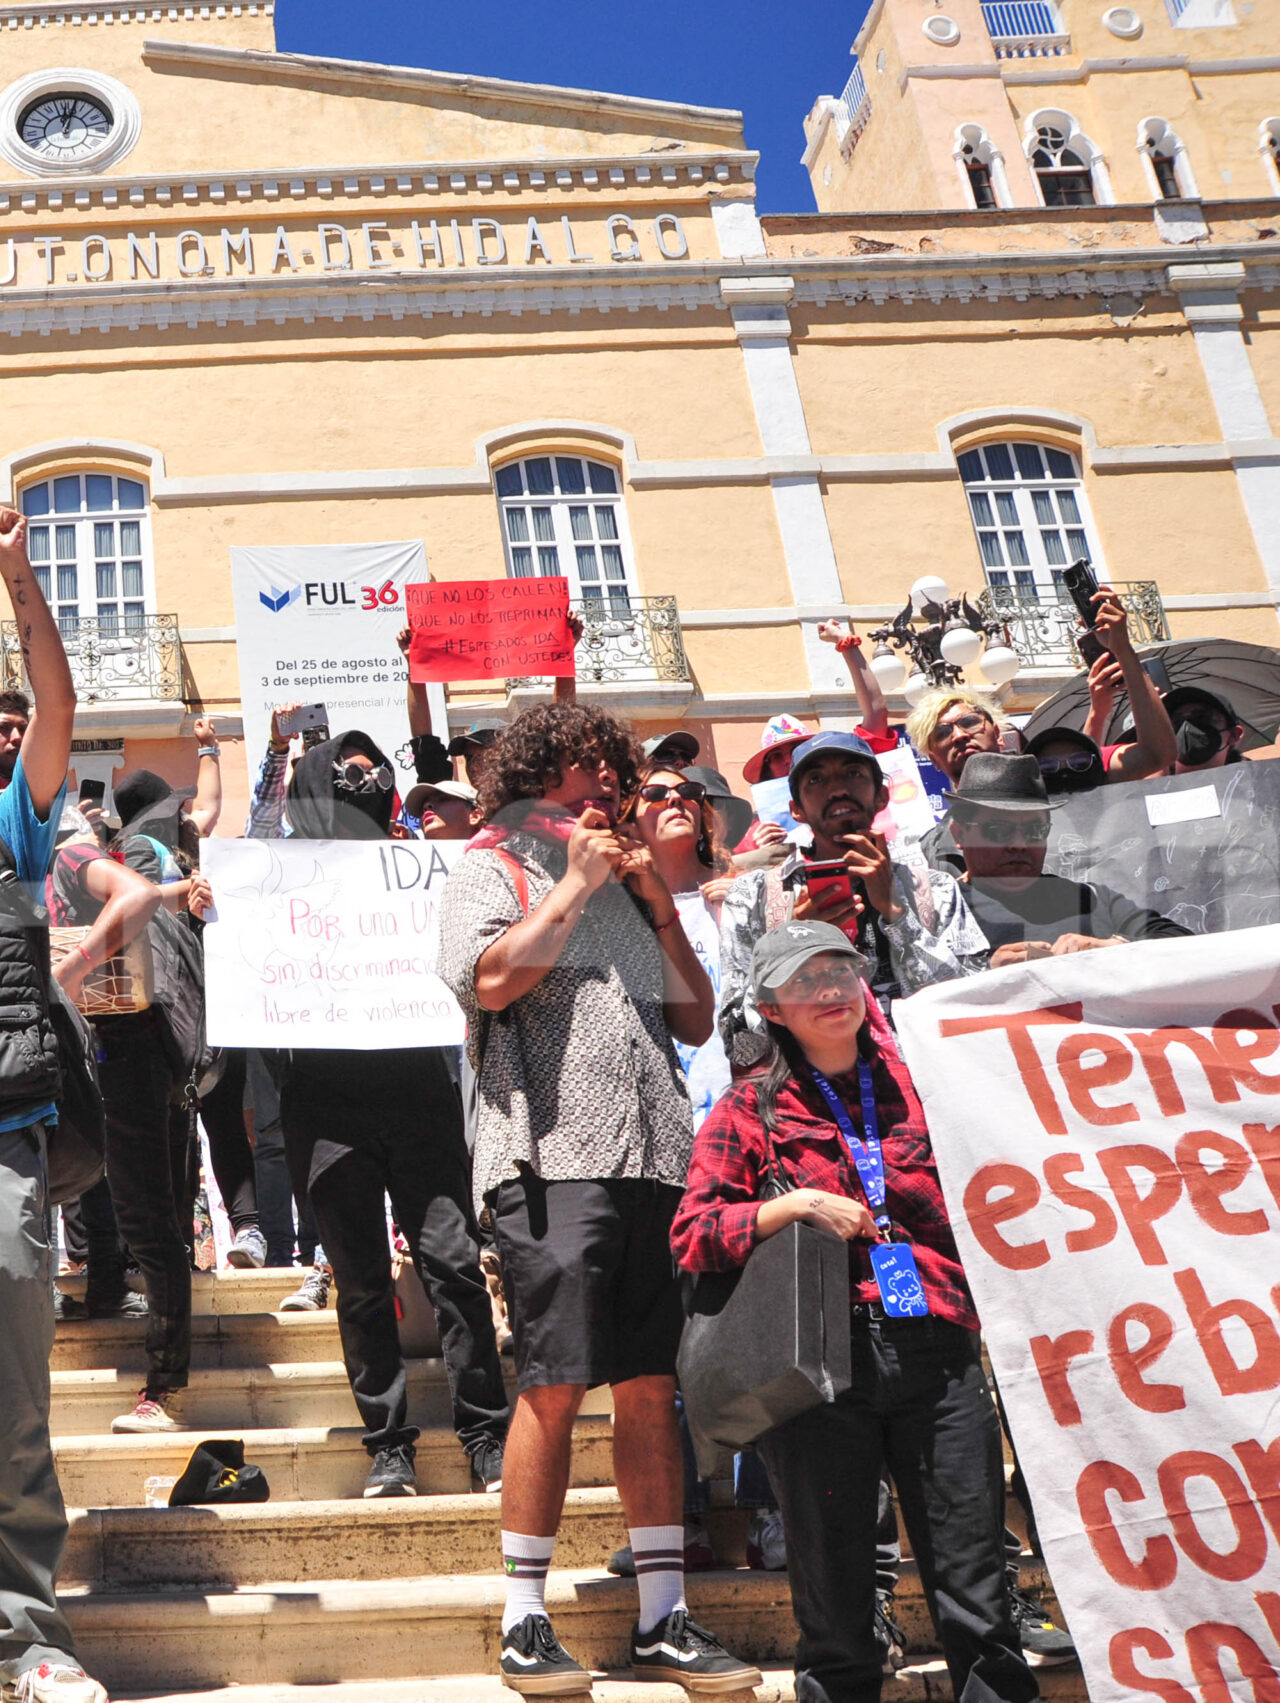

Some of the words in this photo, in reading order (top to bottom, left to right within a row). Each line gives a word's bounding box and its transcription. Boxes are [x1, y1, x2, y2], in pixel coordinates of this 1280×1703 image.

[318, 221, 393, 270] DE
[411, 213, 688, 268] HIDALGO
[304, 582, 356, 605] FUL
[361, 579, 399, 610] 36
[444, 591, 460, 603] NO
[466, 588, 495, 602] LOS
[376, 605, 405, 613] edición
[449, 612, 465, 625] NO
[533, 631, 560, 646] IDA
[276, 660, 297, 671] Del
[301, 659, 317, 670] 25
[321, 658, 338, 669] de
[342, 658, 388, 671] agosto
[391, 656, 403, 666] al
[261, 676, 269, 687] 3
[273, 676, 290, 686] de
[293, 672, 369, 688] septiembre
[372, 672, 389, 683] de
[326, 697, 385, 710] presencial
[379, 844, 449, 892] IDA
[358, 910, 400, 938] una
[260, 962, 296, 985] sin
[263, 994, 312, 1025] libre
[324, 1002, 349, 1023] de
[366, 997, 452, 1022] violencia
[938, 1001, 1280, 1135] Tene
[1029, 1267, 1280, 1428] reb
